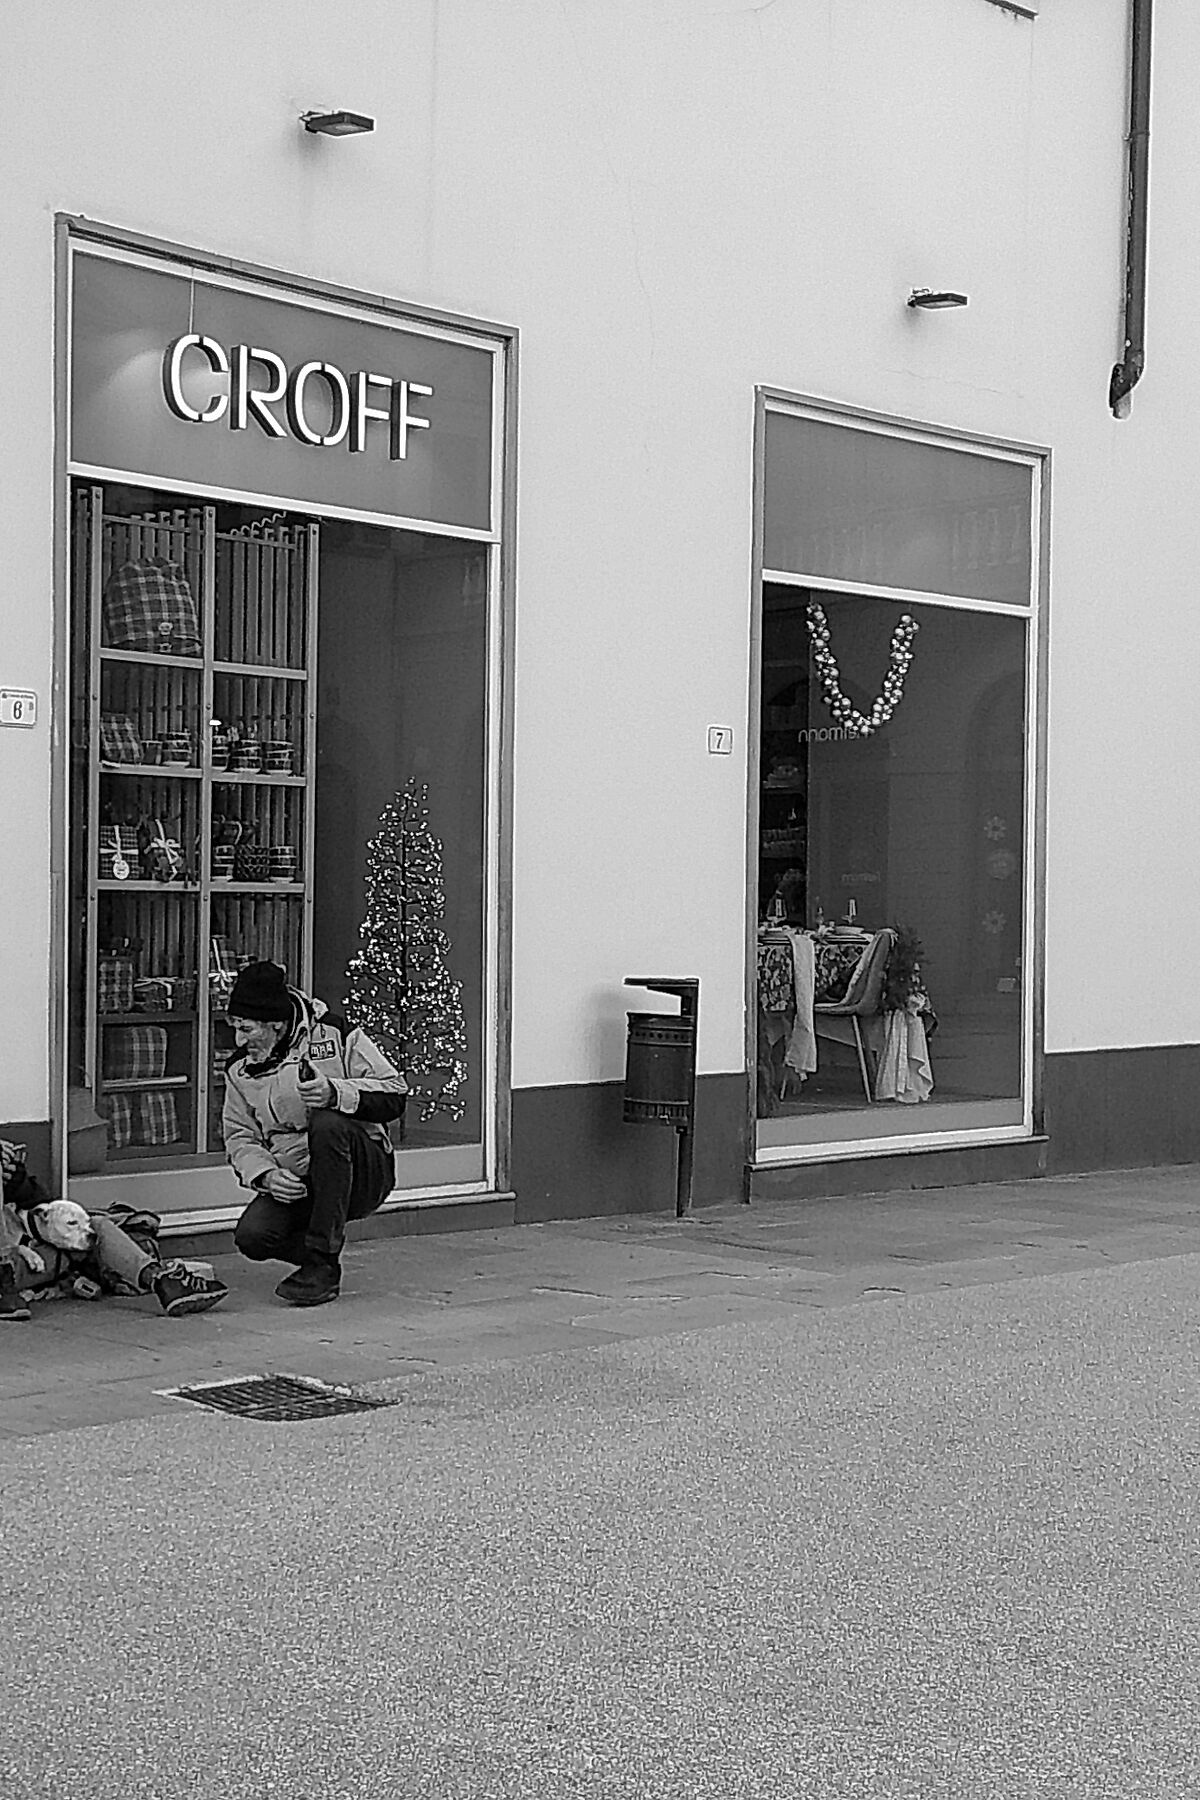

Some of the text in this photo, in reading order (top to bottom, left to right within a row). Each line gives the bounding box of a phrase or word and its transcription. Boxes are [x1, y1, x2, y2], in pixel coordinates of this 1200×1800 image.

[164, 334, 433, 460] CROFF
[13, 700, 22, 720] 6
[716, 732, 724, 749] 7
